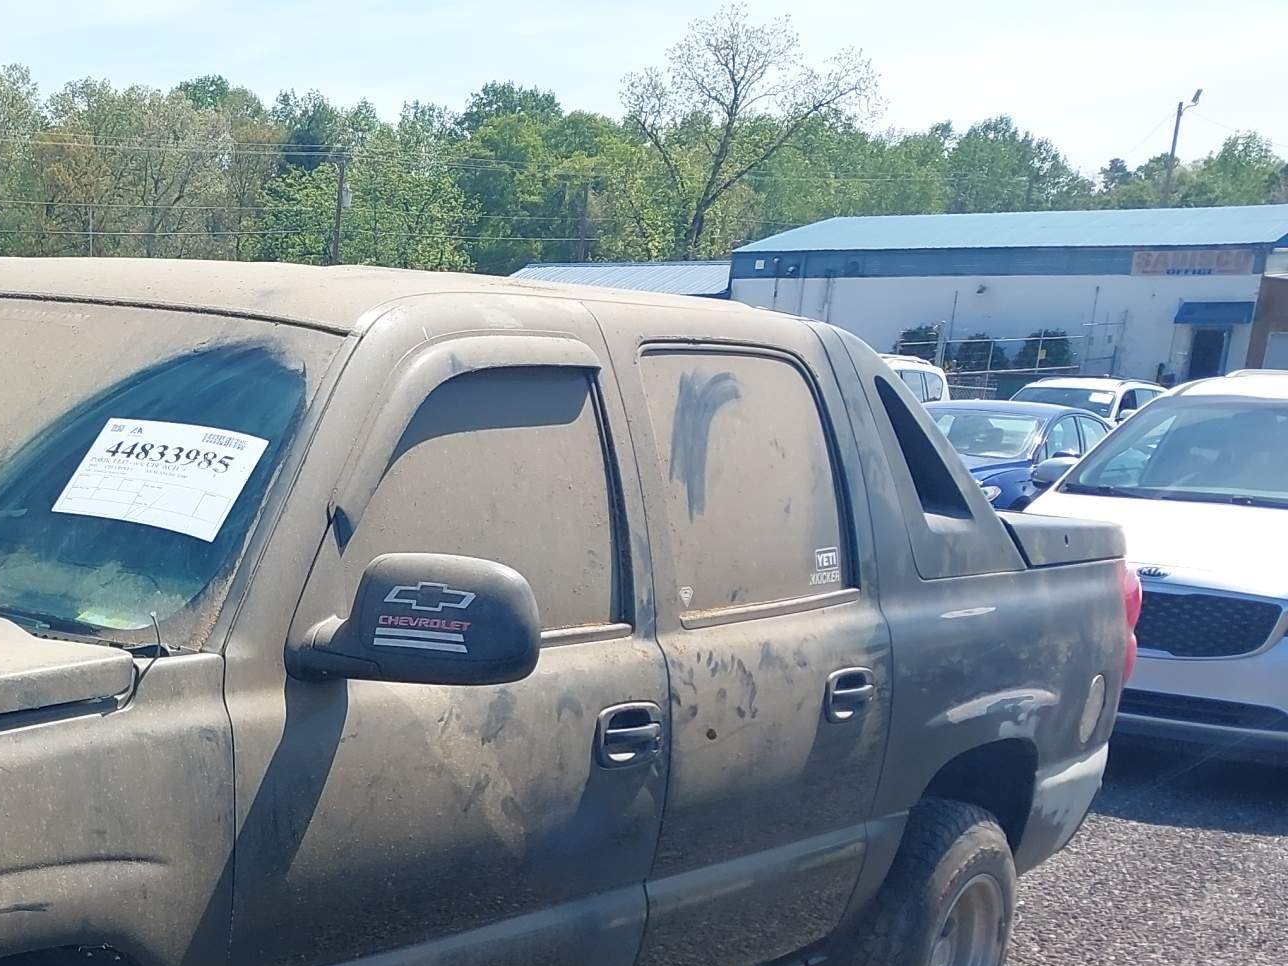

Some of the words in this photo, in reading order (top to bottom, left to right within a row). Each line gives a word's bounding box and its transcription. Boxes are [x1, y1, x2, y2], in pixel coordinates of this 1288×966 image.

[105, 440, 235, 474] 44833985
[817, 551, 837, 567] YETI
[378, 615, 472, 631] CHEVROLET
